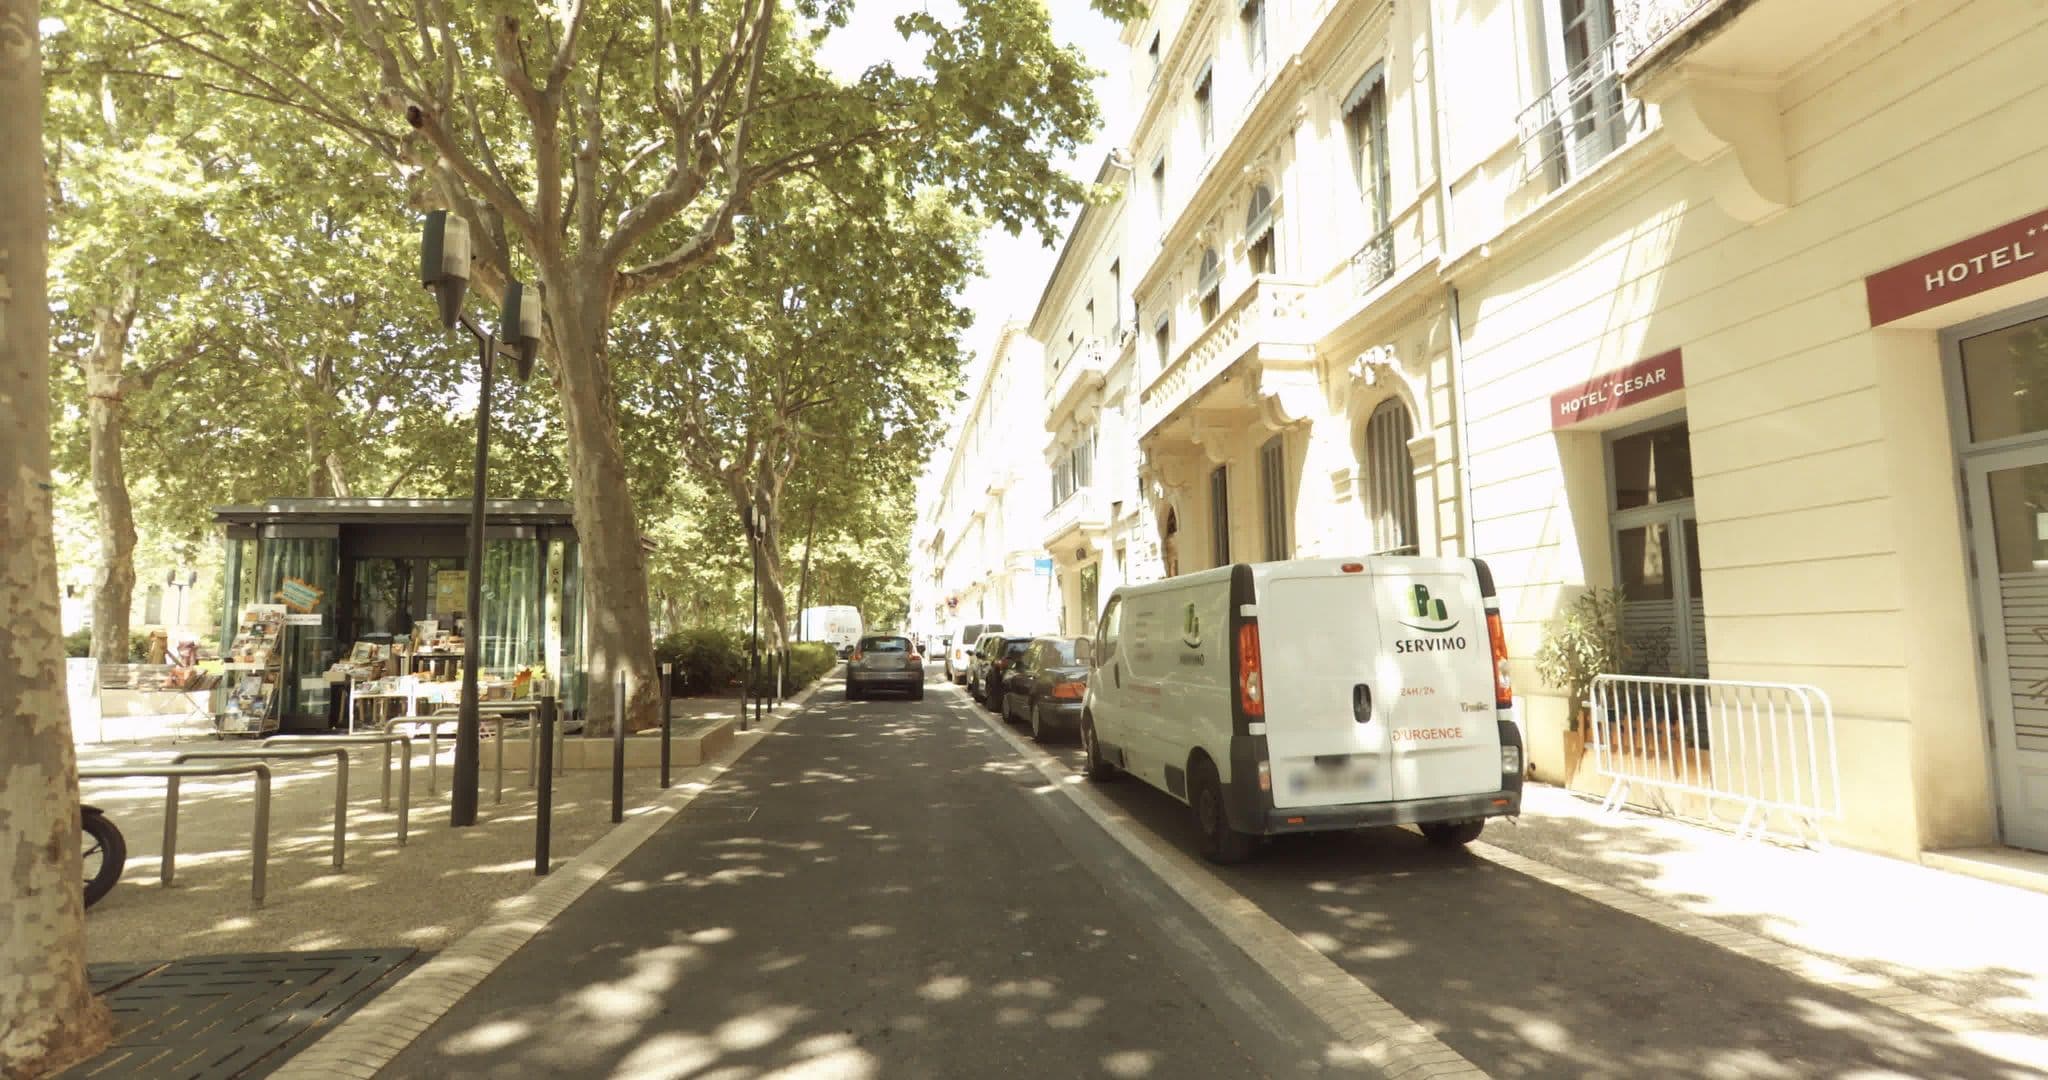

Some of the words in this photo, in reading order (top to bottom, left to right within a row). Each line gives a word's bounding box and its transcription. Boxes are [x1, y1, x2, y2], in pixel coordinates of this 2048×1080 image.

[1924, 241, 2035, 292] HOTEL
[1560, 391, 1608, 415] HOTEL
[1613, 368, 1666, 397] CESAR
[1395, 636, 1466, 654] SERVIMO
[1392, 727, 1463, 741] D'URGENCE
